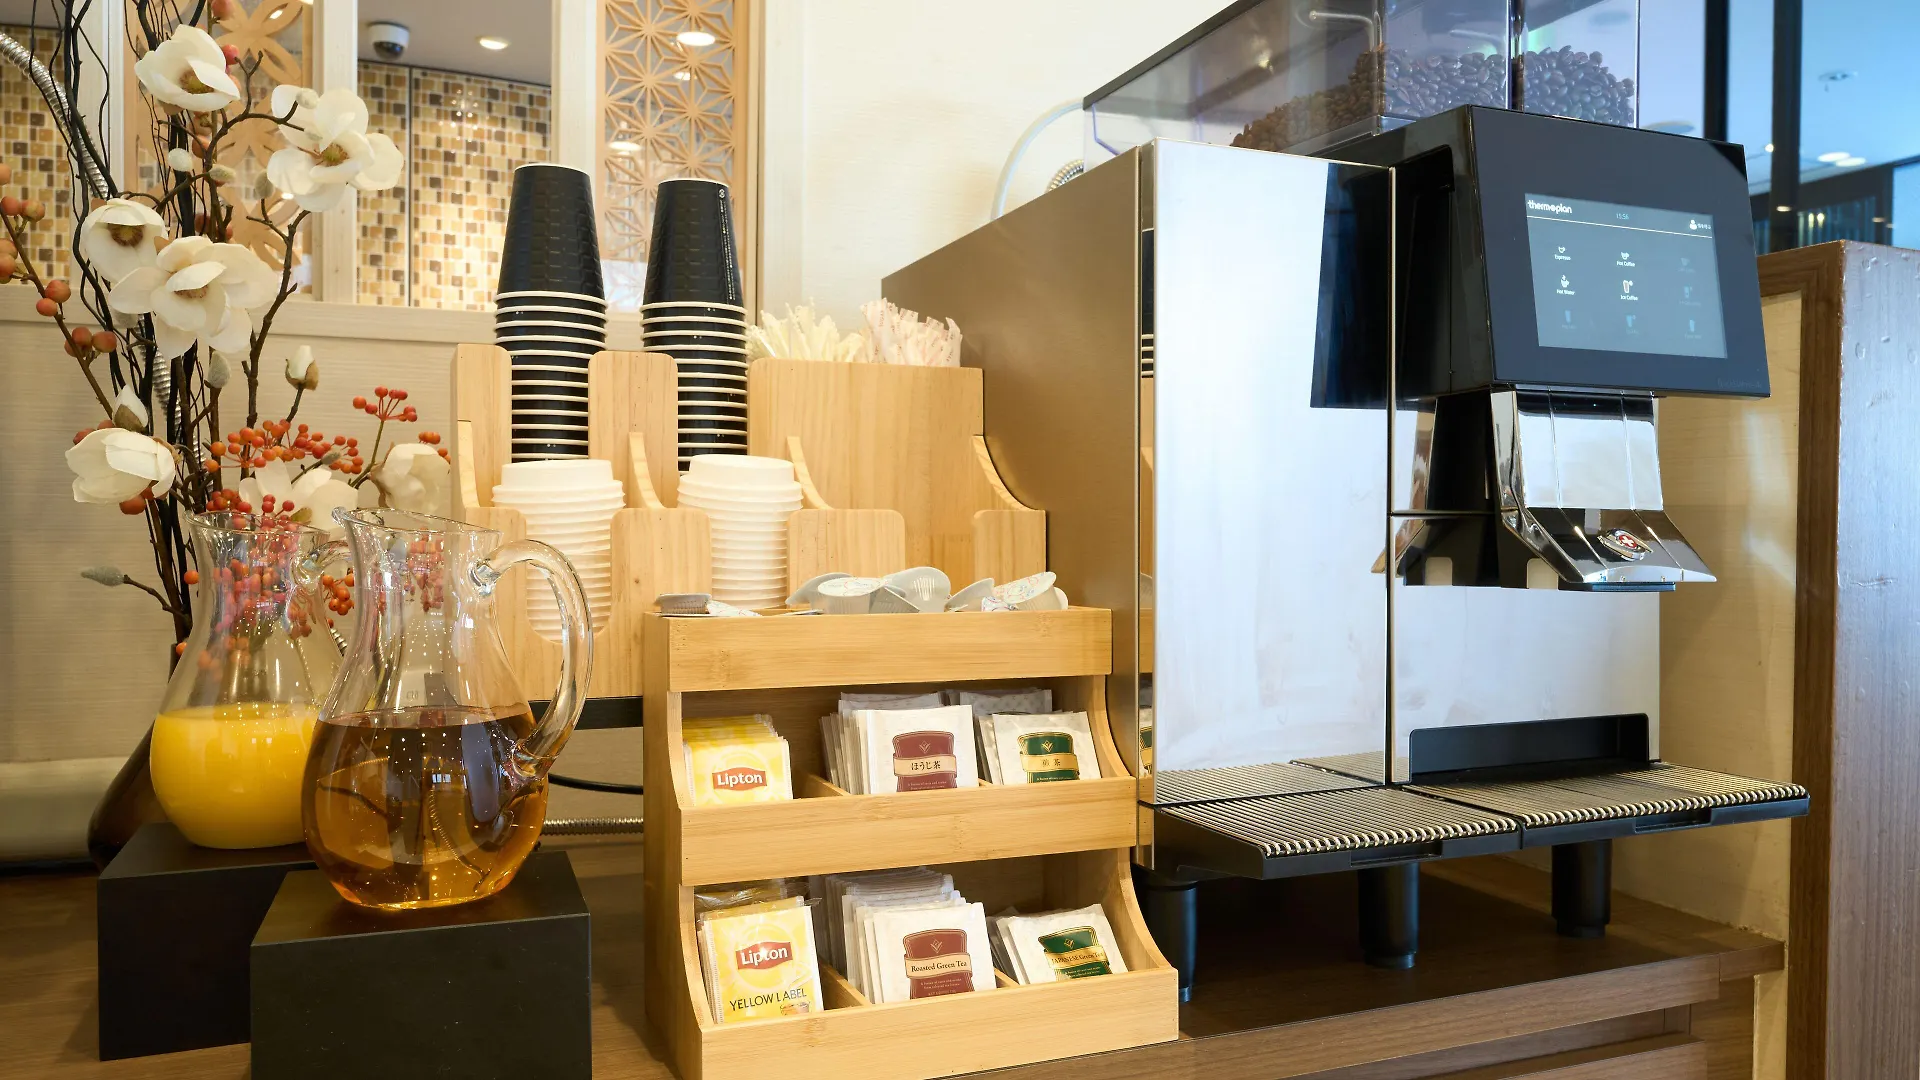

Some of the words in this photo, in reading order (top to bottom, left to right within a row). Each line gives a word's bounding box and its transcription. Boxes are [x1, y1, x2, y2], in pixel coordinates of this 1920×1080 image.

[1528, 199, 1572, 214] thermoplan
[911, 760, 941, 771] ほうじ茶
[717, 772, 763, 787] Lipton
[741, 947, 788, 966] Lipton
[911, 962, 936, 972] Roasted
[936, 962, 955, 970] Green
[730, 993, 774, 1011] YELLOW
[776, 988, 807, 1002] LABEL
